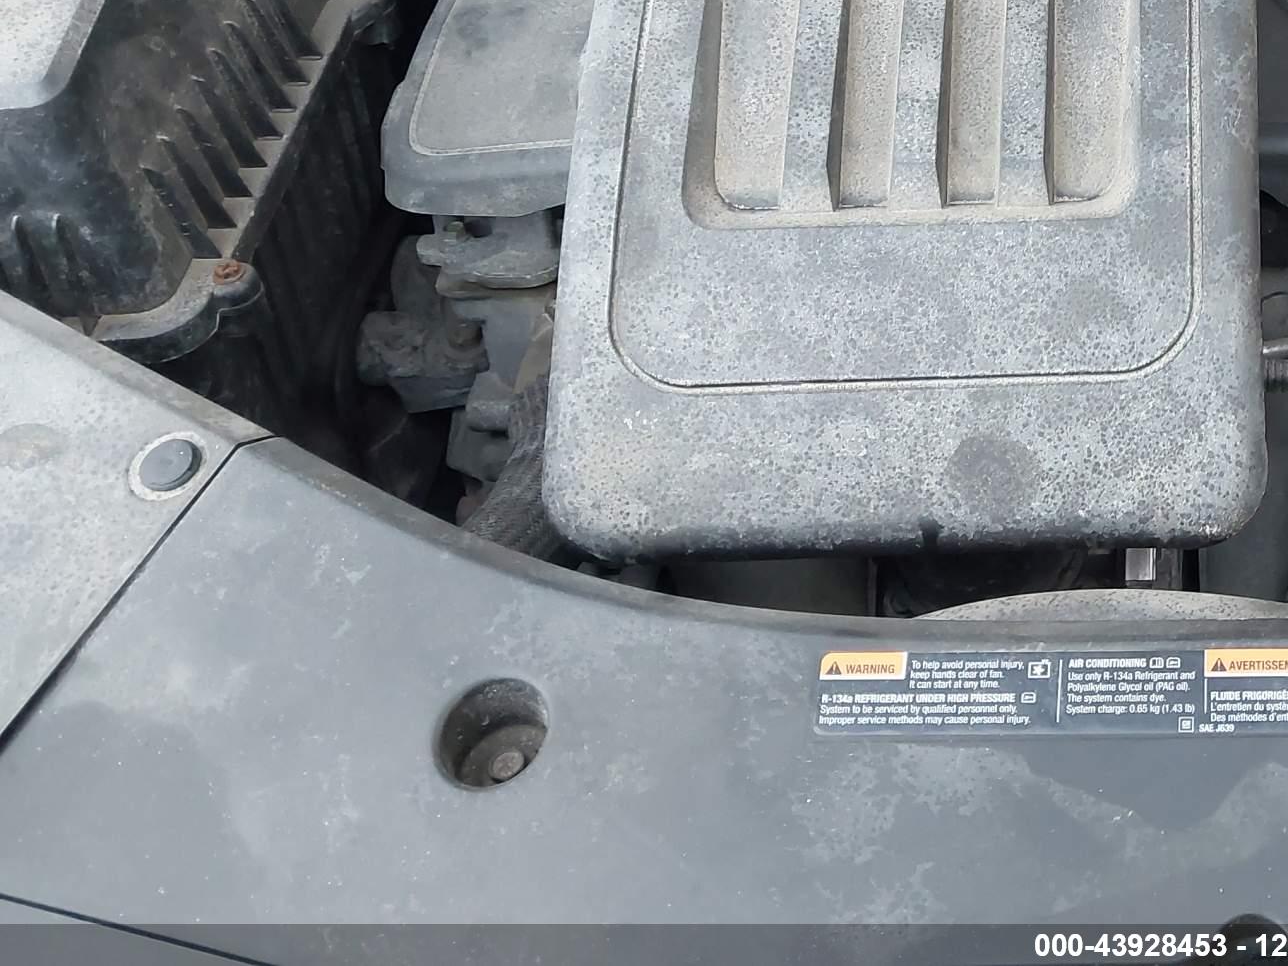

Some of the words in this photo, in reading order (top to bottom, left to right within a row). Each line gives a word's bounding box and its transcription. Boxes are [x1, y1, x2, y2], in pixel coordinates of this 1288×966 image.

[912, 660, 921, 669] To
[923, 660, 939, 670] help
[942, 660, 962, 669] avoid
[965, 660, 998, 670] personal
[1001, 660, 1024, 670] injury,
[1069, 659, 1083, 668] AIR
[1086, 659, 1146, 668] CONDITIONING
[846, 664, 895, 674] WARNING
[910, 671, 929, 680] keep
[932, 671, 956, 679] hands
[958, 671, 977, 679] clear
[980, 671, 987, 679] of
[989, 671, 1003, 679] fan.
[1068, 672, 1082, 680] Use
[1085, 672, 1101, 682] only
[1104, 672, 1132, 680] R-134a
[1135, 671, 1178, 682] Refrigerant
[1180, 671, 1195, 679] and
[910, 680, 915, 688] It
[917, 680, 931, 688] can
[933, 680, 951, 688] start
[954, 680, 961, 688] at
[964, 681, 978, 690] any
[980, 680, 1000, 688] time.
[822, 694, 853, 703] R-134a
[855, 694, 913, 703] REFRIGERANT
[916, 694, 945, 703] UNDER
[948, 694, 968, 703] HIGH
[970, 694, 1015, 703] PRESSURE
[1067, 694, 1081, 702] The
[1084, 694, 1112, 704] system
[1114, 694, 1148, 702] contains
[1150, 693, 1166, 703] dye.
[1211, 691, 1240, 700] FLUIDE
[820, 705, 850, 715] System
[853, 705, 859, 714] to
[862, 705, 872, 714] be
[874, 705, 908, 714] serviced
[911, 705, 919, 715] by
[922, 705, 956, 715] qualified
[958, 705, 997, 715] personnel
[999, 705, 1017, 715] only.
[1066, 705, 1095, 715] System
[1098, 705, 1127, 715] charge:
[1129, 705, 1148, 713] 0.65
[1150, 704, 1160, 715] kg
[1162, 704, 1182, 714] (1.43
[1185, 704, 1195, 714] lb)
[819, 715, 855, 725] Improper
[857, 715, 886, 724] service
[889, 715, 923, 724] methods
[925, 716, 942, 725] may
[944, 715, 968, 724] cause
[970, 715, 1004, 725] personal
[1006, 715, 1031, 725] injury.
[1198, 723, 1214, 732] SAE
[1215, 723, 1235, 733] J639
